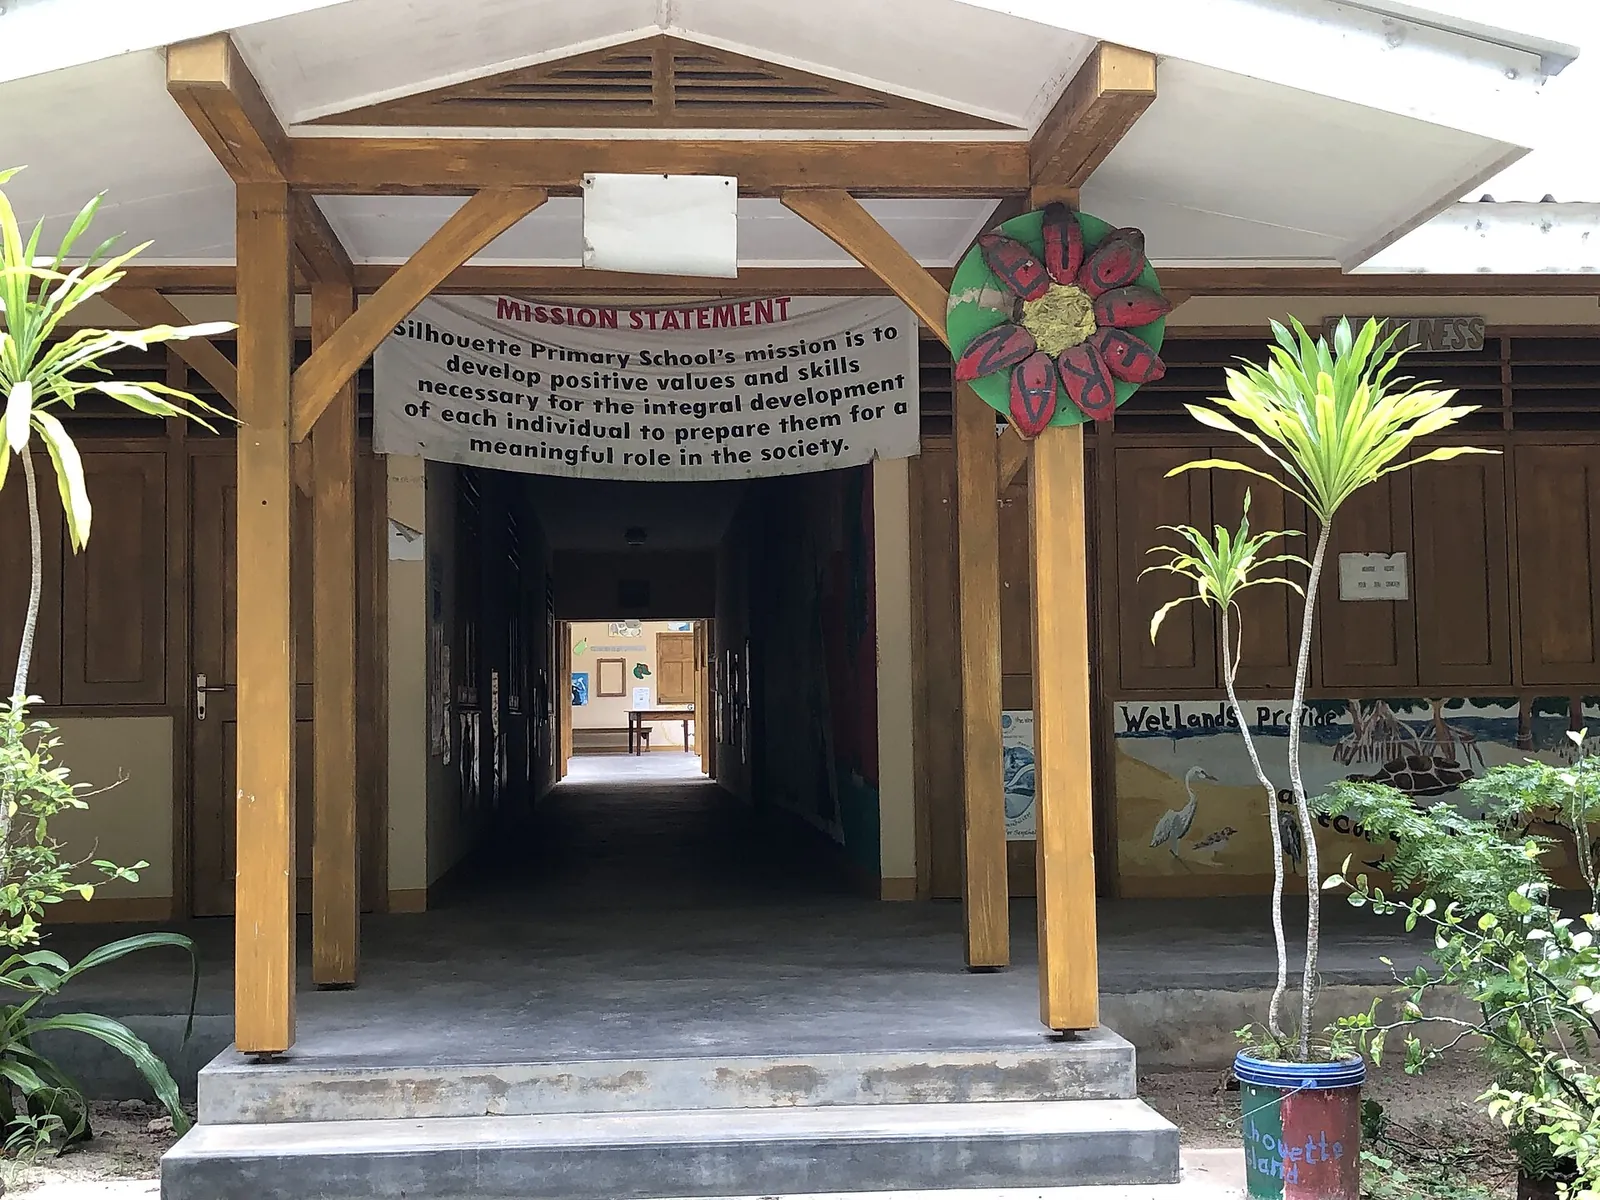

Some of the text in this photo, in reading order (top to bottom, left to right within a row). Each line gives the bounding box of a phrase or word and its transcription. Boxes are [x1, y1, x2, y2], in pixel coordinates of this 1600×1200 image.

[496, 297, 791, 330] MISSION STATEMENT
[394, 319, 898, 369] Silhouette Primary School's mission is to
[446, 355, 860, 391] develop positive values and skills
[418, 374, 905, 419] necessary for the integral development
[404, 401, 908, 444] of each individual to prepare them for a
[470, 438, 849, 467] meaningful role in the society.
